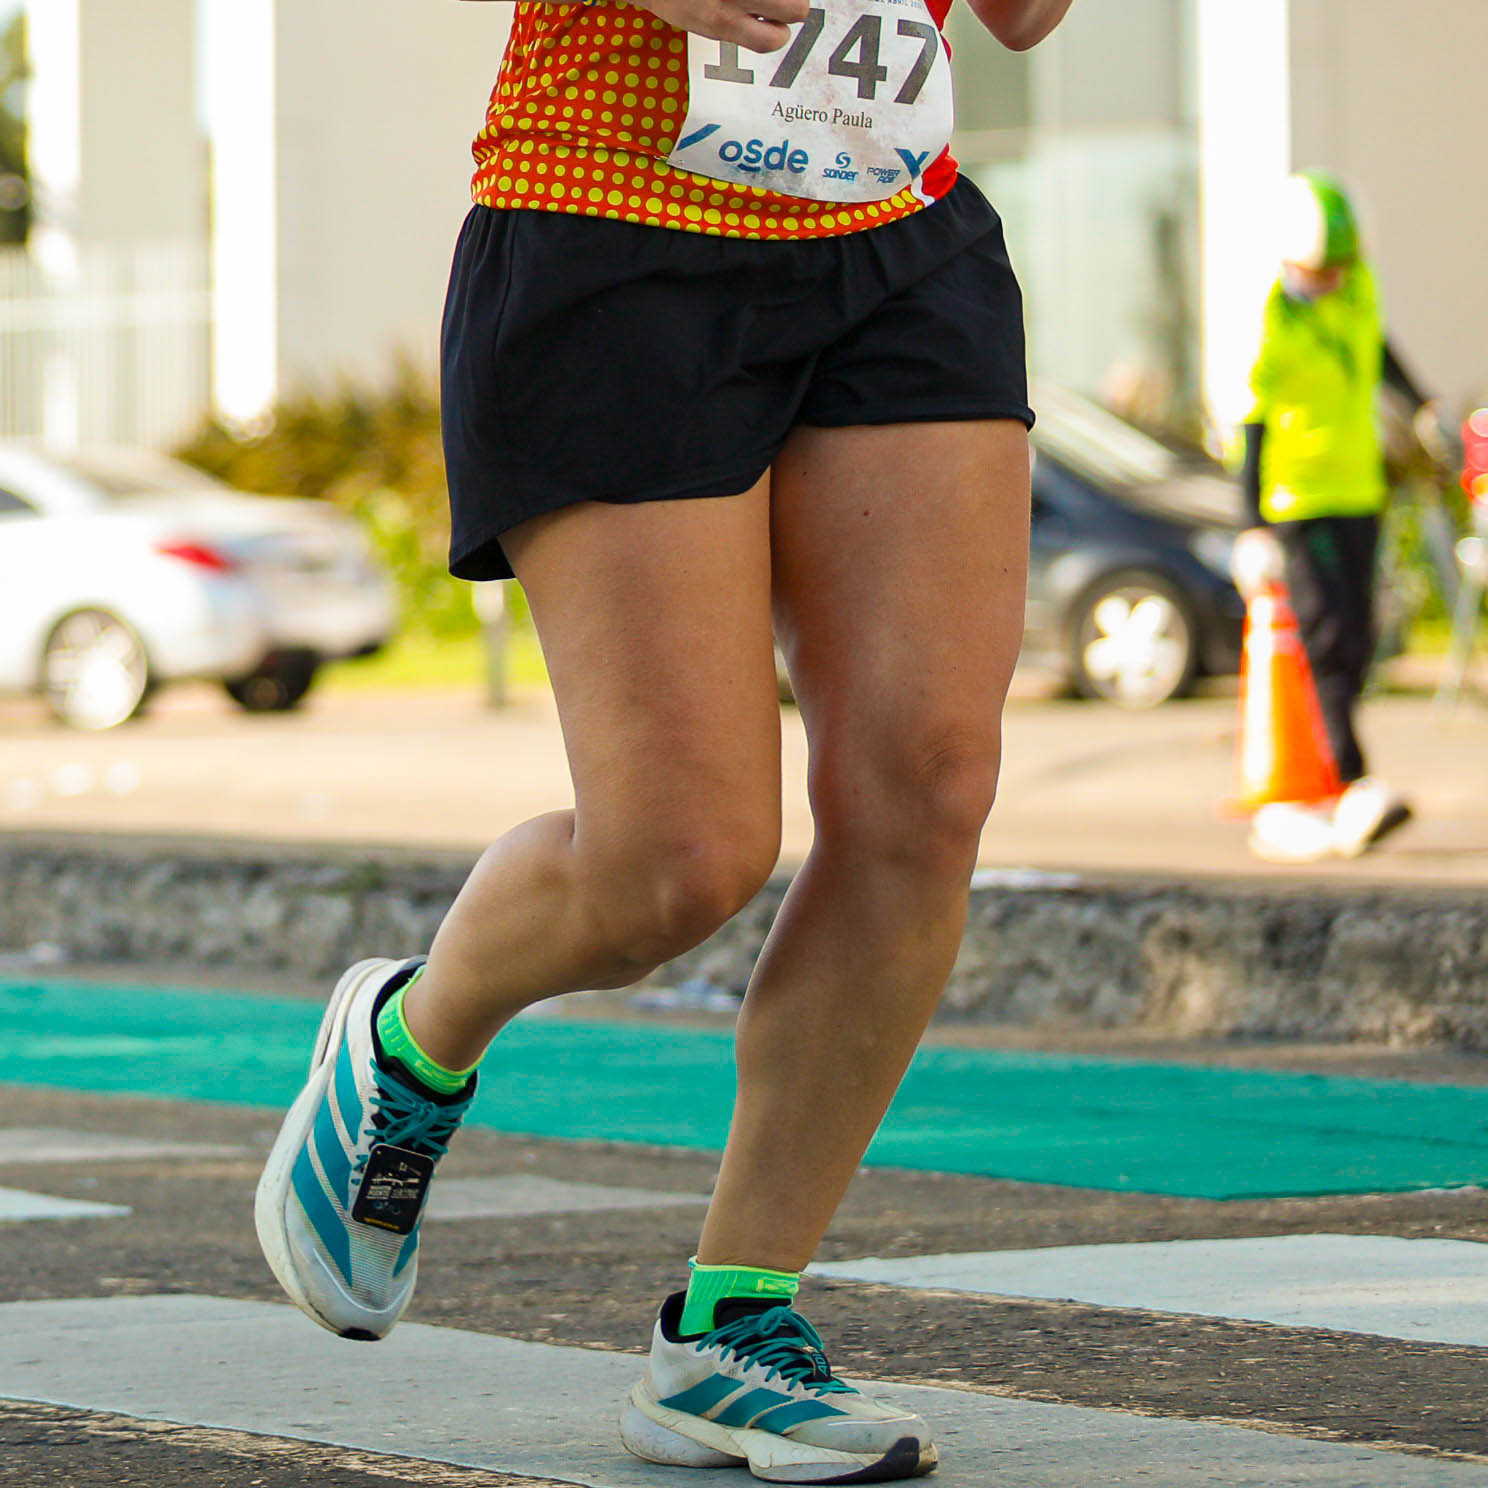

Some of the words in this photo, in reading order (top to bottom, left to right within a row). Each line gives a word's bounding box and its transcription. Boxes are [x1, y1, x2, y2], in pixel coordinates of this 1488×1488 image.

[704, 8, 938, 104] 1747
[771, 101, 828, 124] Agüero
[832, 108, 873, 128] Paula
[718, 139, 809, 173] osde
